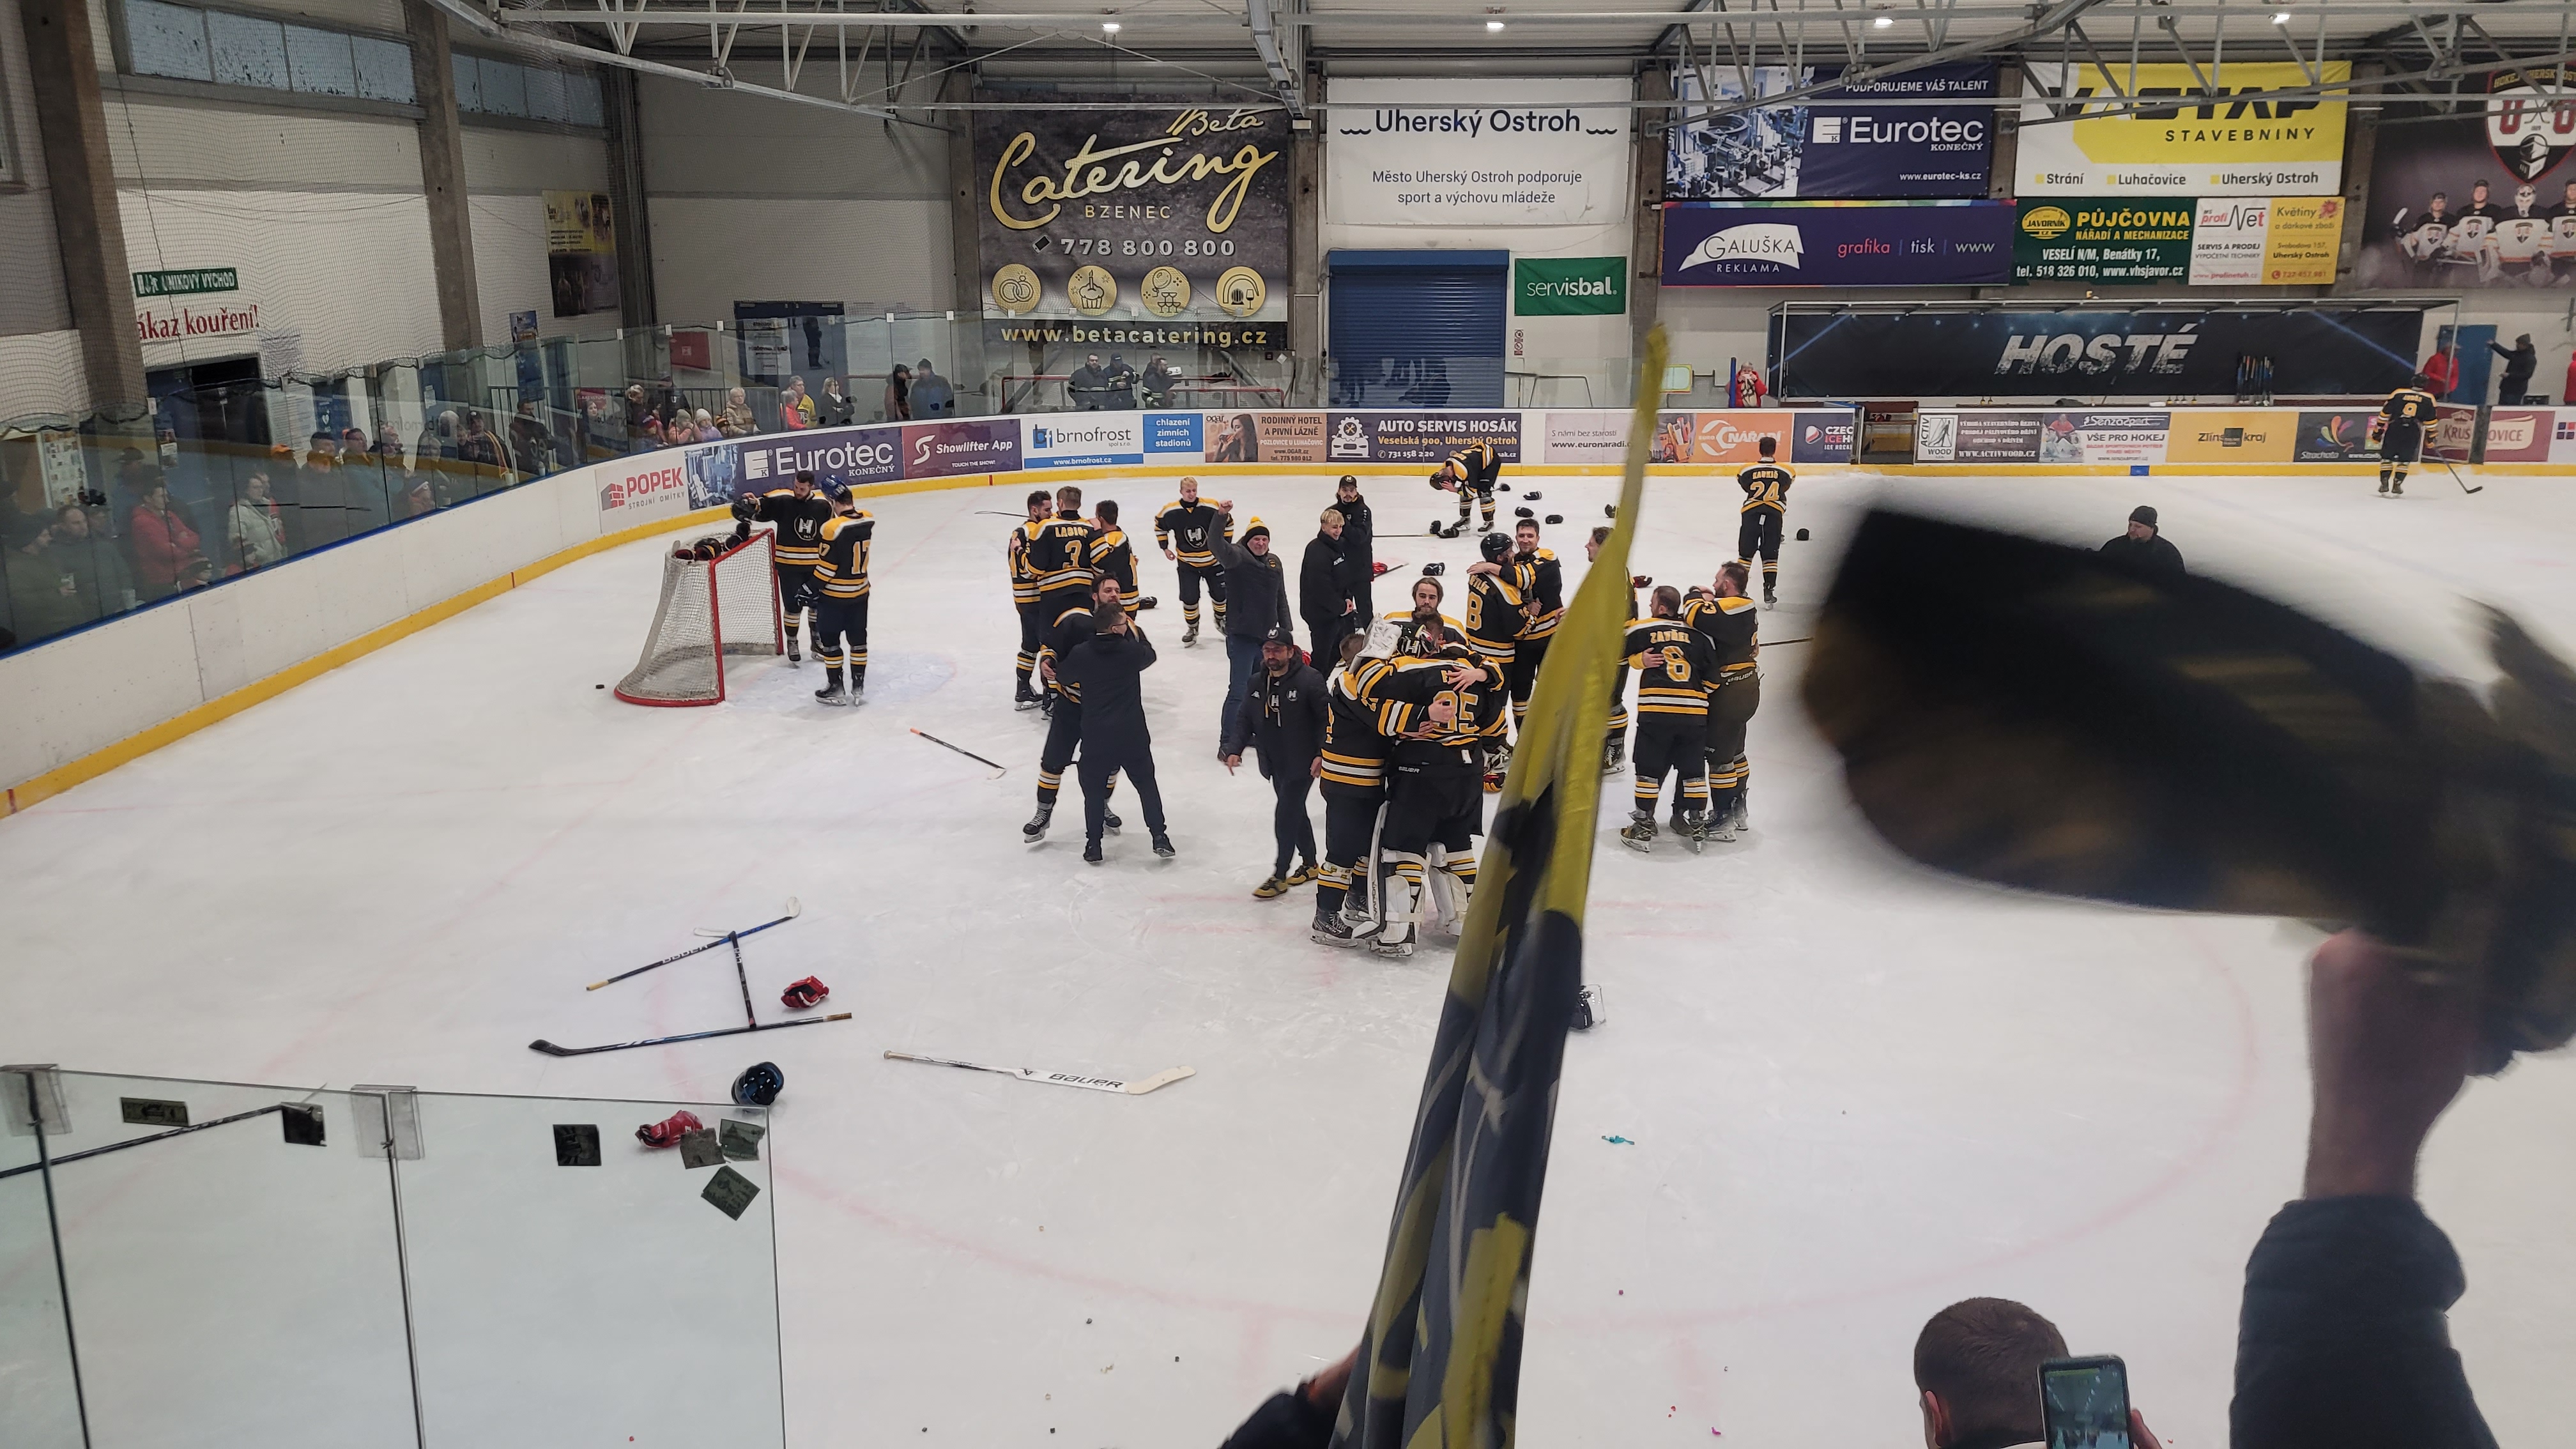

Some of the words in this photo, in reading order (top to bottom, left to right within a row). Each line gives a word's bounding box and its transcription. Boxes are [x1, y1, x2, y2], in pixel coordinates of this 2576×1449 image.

[1925, 79, 1947, 91] VÁŠ
[1948, 80, 1988, 91] TALENT
[1165, 109, 1285, 135] Beta
[1376, 109, 1482, 137] Uherský
[1489, 109, 1581, 133] Ostroh
[1850, 116, 1983, 143] Eurotec
[2165, 128, 2315, 142] STAVEBNINY
[990, 131, 1278, 233] Catering
[1372, 170, 1412, 183] Město
[1416, 170, 1468, 185] Uherský
[1471, 170, 1514, 183] Ostroh
[1518, 170, 1582, 185] podporuje
[1899, 171, 1981, 181] www.eurotec-ks.cz
[2047, 172, 2085, 185] Strání
[2119, 172, 2186, 185] Luhačovice
[2222, 172, 2273, 187] Uherský
[2277, 171, 2319, 184] Ostroh
[1398, 192, 1430, 206] sport
[1435, 194, 1442, 204] a
[1446, 191, 1498, 206] výchovu
[1502, 191, 1555, 204] mládeže
[1085, 205, 1171, 219] BZENEC
[2077, 208, 2190, 227] PŮJČOVNA
[2277, 207, 2317, 218] Květiny
[2076, 228, 2111, 240] NÁŘADÍ
[2113, 231, 2120, 240] A
[2124, 231, 2189, 240] MECHANIZACE
[1061, 238, 1112, 256] 778
[1123, 238, 1174, 256] 800
[1184, 239, 1236, 256] 800
[1704, 235, 1795, 259] GALUŠKA
[1837, 238, 1890, 257] grafika
[1911, 239, 1935, 254] tisk
[1956, 241, 1995, 252] www
[2043, 246, 2076, 261] VESELÍ
[2077, 248, 2099, 262] N/M,
[2103, 248, 2142, 263] Benátky
[2145, 248, 2161, 262] 17,
[1717, 263, 1781, 273] REKLAMA
[2016, 265, 2033, 277] tel.
[2036, 265, 2054, 277] 518
[2057, 265, 2075, 277] 326
[2078, 265, 2099, 279] 010,
[2103, 265, 2183, 279] www.vhsjavor.cz
[137, 310, 181, 340] ákaz
[184, 303, 259, 335] kouření!
[1001, 325, 1267, 348] www.betacatering.cz
[1994, 323, 2199, 375] HOSTÉ
[1156, 418, 1190, 427] chlazení
[1261, 415, 1296, 424] RODINNÝ
[1377, 420, 1414, 433] AUTO
[1417, 420, 1467, 433] SERVIS
[1470, 417, 1517, 433] HOSÁK
[1057, 427, 1131, 443] brnofrost
[1156, 428, 1189, 436] zimních
[1272, 426, 1292, 436] PIVNÍ
[1294, 426, 1319, 436] LÁZNĚ
[2087, 433, 2106, 441] VŠE
[936, 441, 989, 454] Showlifter
[992, 440, 1013, 451] App
[1155, 438, 1191, 447] stadionů
[1377, 436, 1419, 445] Veselská
[1486, 436, 1517, 445] Ostroh
[1552, 440, 1631, 448] www.euronaradi.c
[776, 441, 894, 475] Eurotec
[1054, 457, 1112, 465] www.brnofrost.cz
[1388, 450, 1402, 459] 731
[848, 463, 895, 477] KONEČNÝ
[625, 466, 685, 498] POPEK
[1749, 481, 1779, 502] 24
[852, 540, 871, 574] 17
